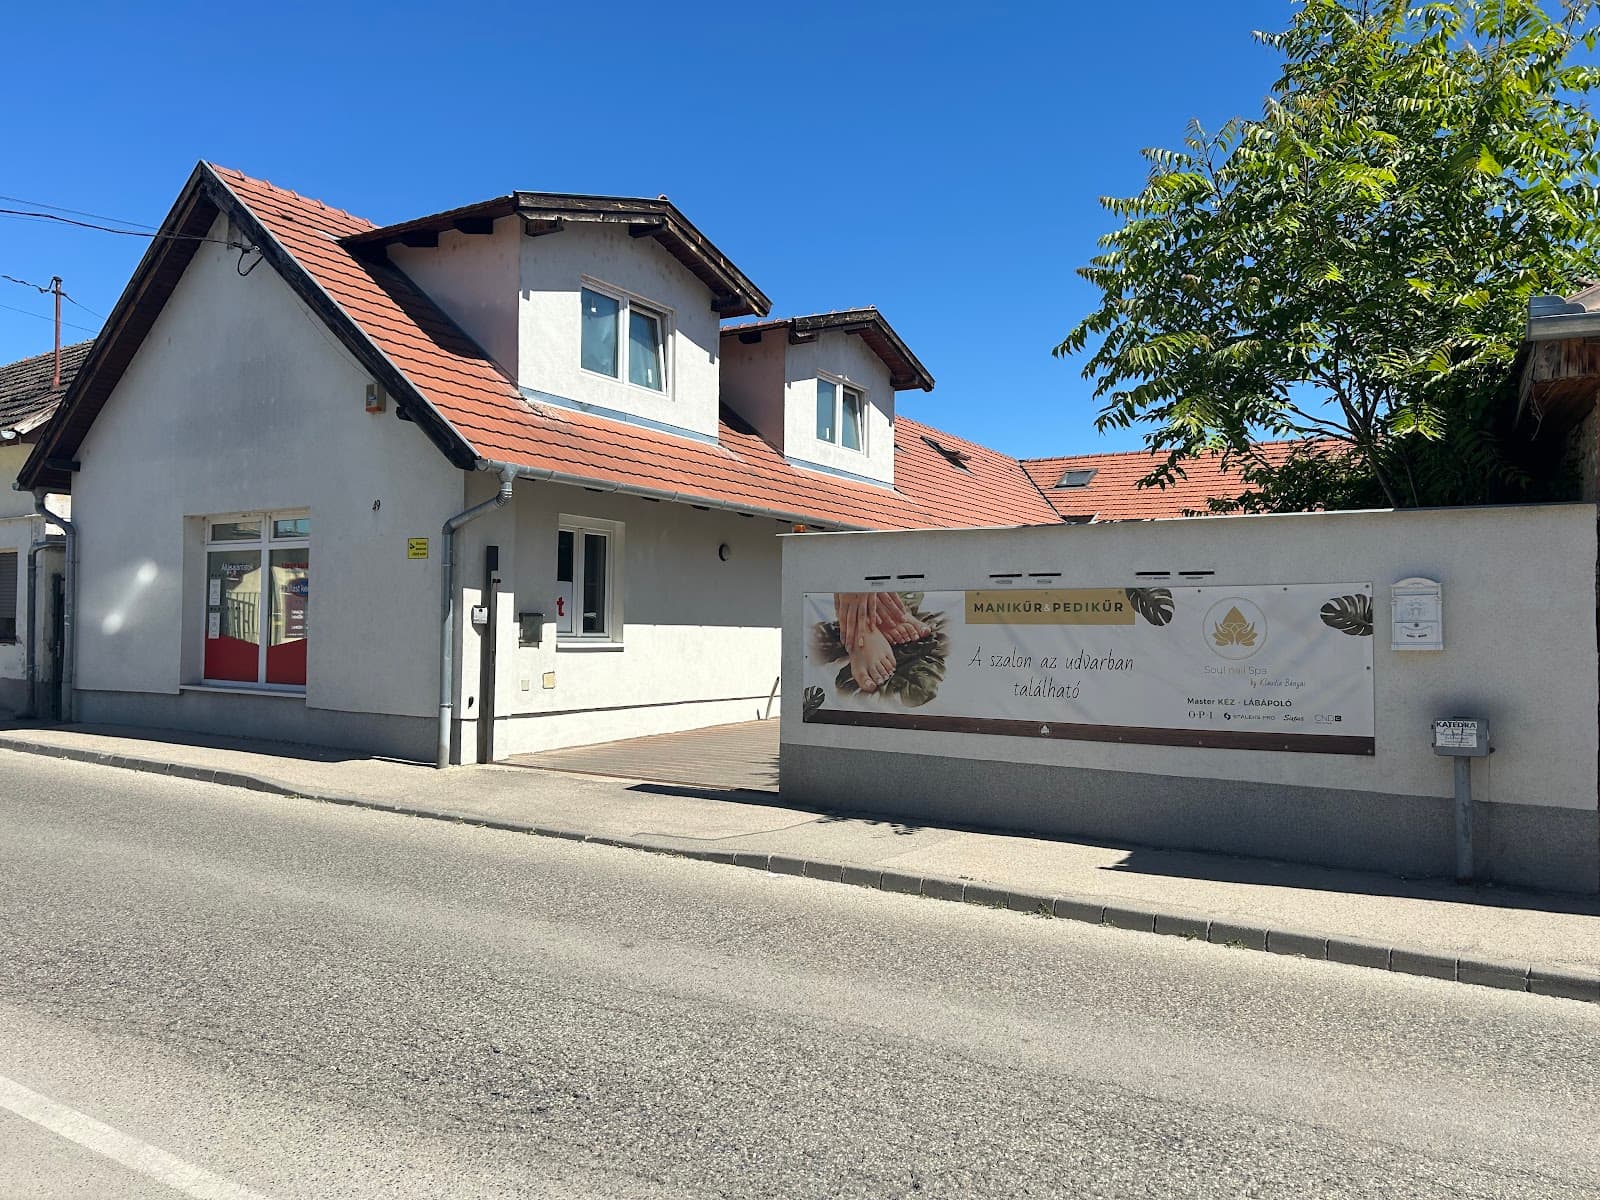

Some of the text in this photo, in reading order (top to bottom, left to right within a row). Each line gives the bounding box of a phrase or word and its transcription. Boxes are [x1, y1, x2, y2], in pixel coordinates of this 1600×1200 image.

[968, 646, 1134, 671] A szalon az udvarban
[1013, 676, 1081, 700] található
[1187, 697, 1215, 705] Master
[1436, 721, 1477, 729] KATEDRA
